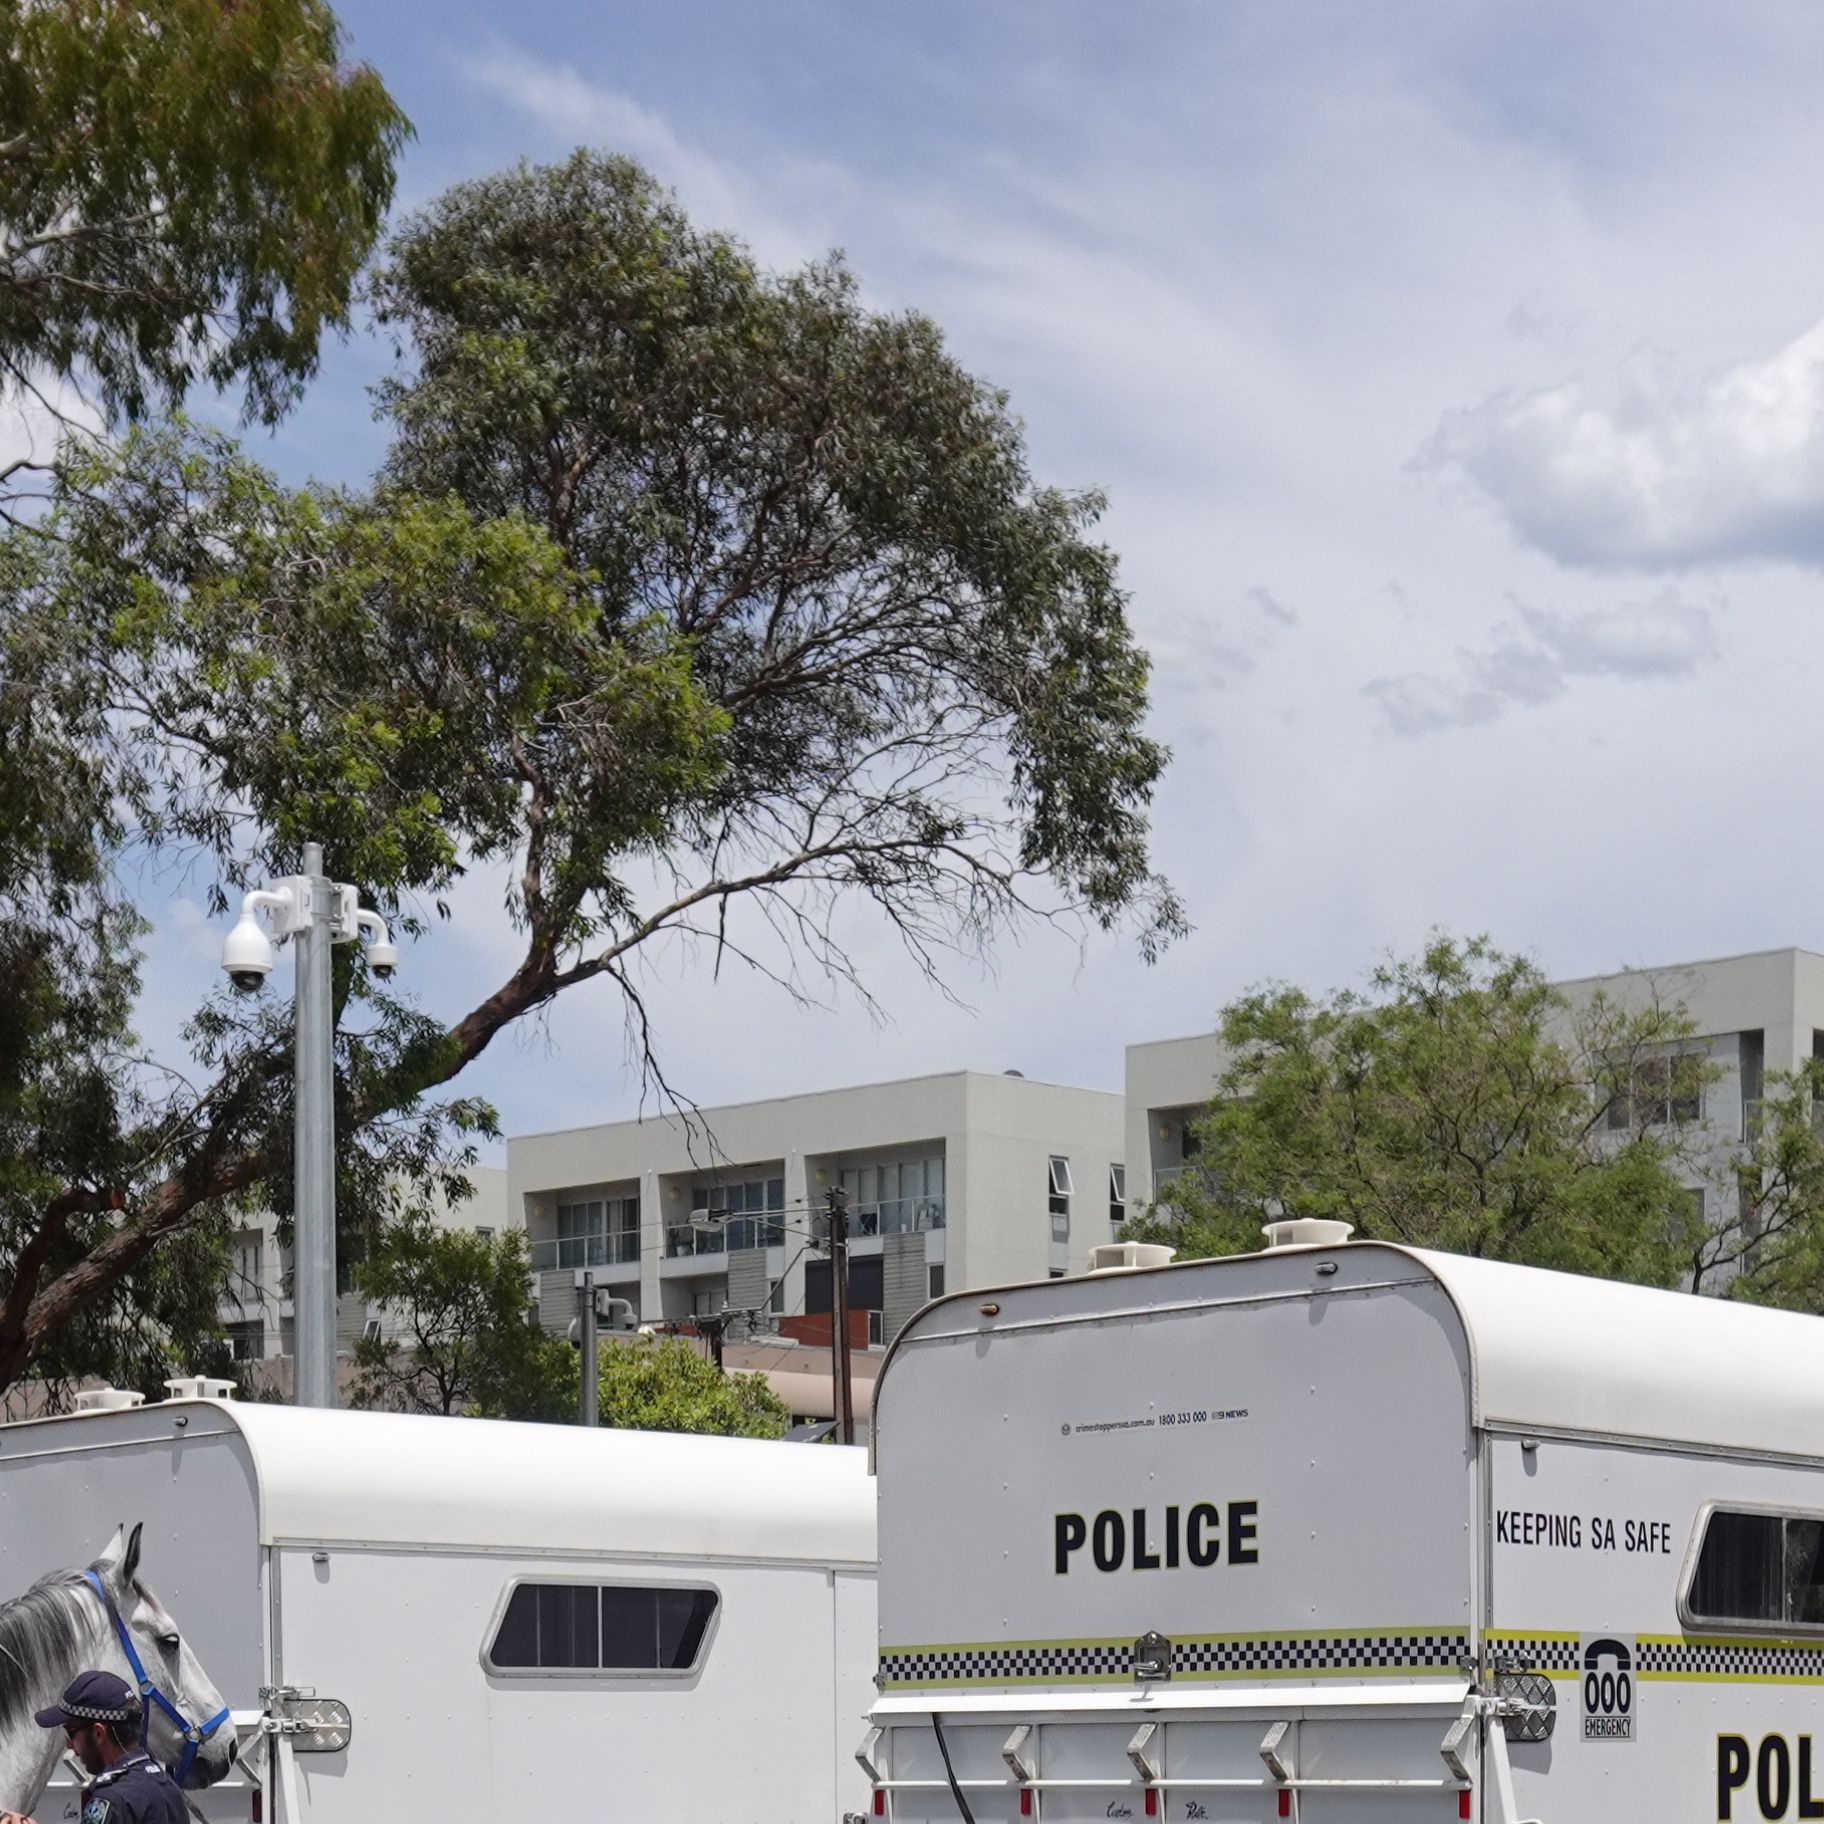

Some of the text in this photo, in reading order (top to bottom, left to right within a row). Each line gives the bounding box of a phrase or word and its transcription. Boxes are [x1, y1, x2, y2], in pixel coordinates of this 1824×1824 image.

[1158, 1413, 1175, 1427] 1800
[1177, 1412, 1191, 1425] 333
[1193, 1410, 1207, 1423] 000
[1055, 1500, 1259, 1575] POLICE
[1497, 1510, 1670, 1553] KEEPING SA SAFE
[1585, 1672, 1631, 1714] 000
[1585, 1717, 1631, 1737] EMERGENCY
